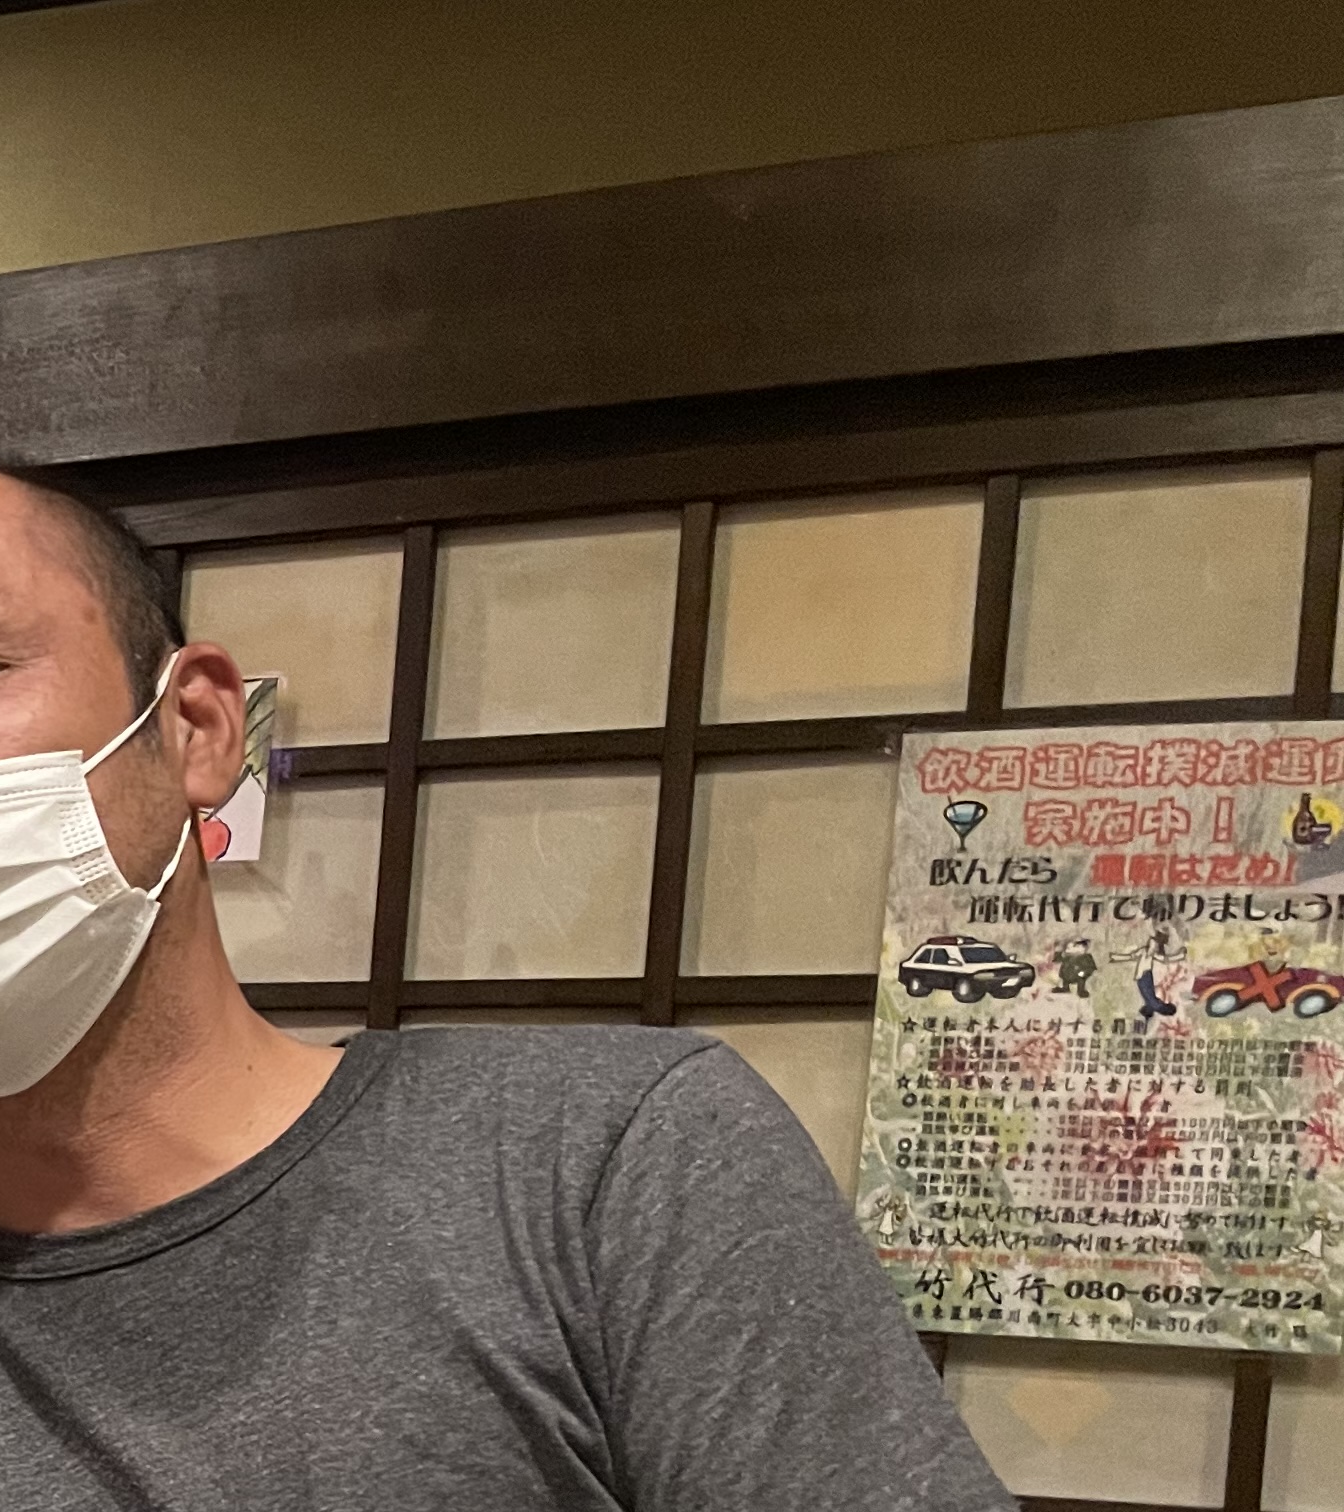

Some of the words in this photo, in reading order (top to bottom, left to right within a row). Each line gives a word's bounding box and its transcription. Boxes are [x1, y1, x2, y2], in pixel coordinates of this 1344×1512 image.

[1024, 796, 1235, 848] 実施中！
[929, 856, 1058, 886] 飲んだら
